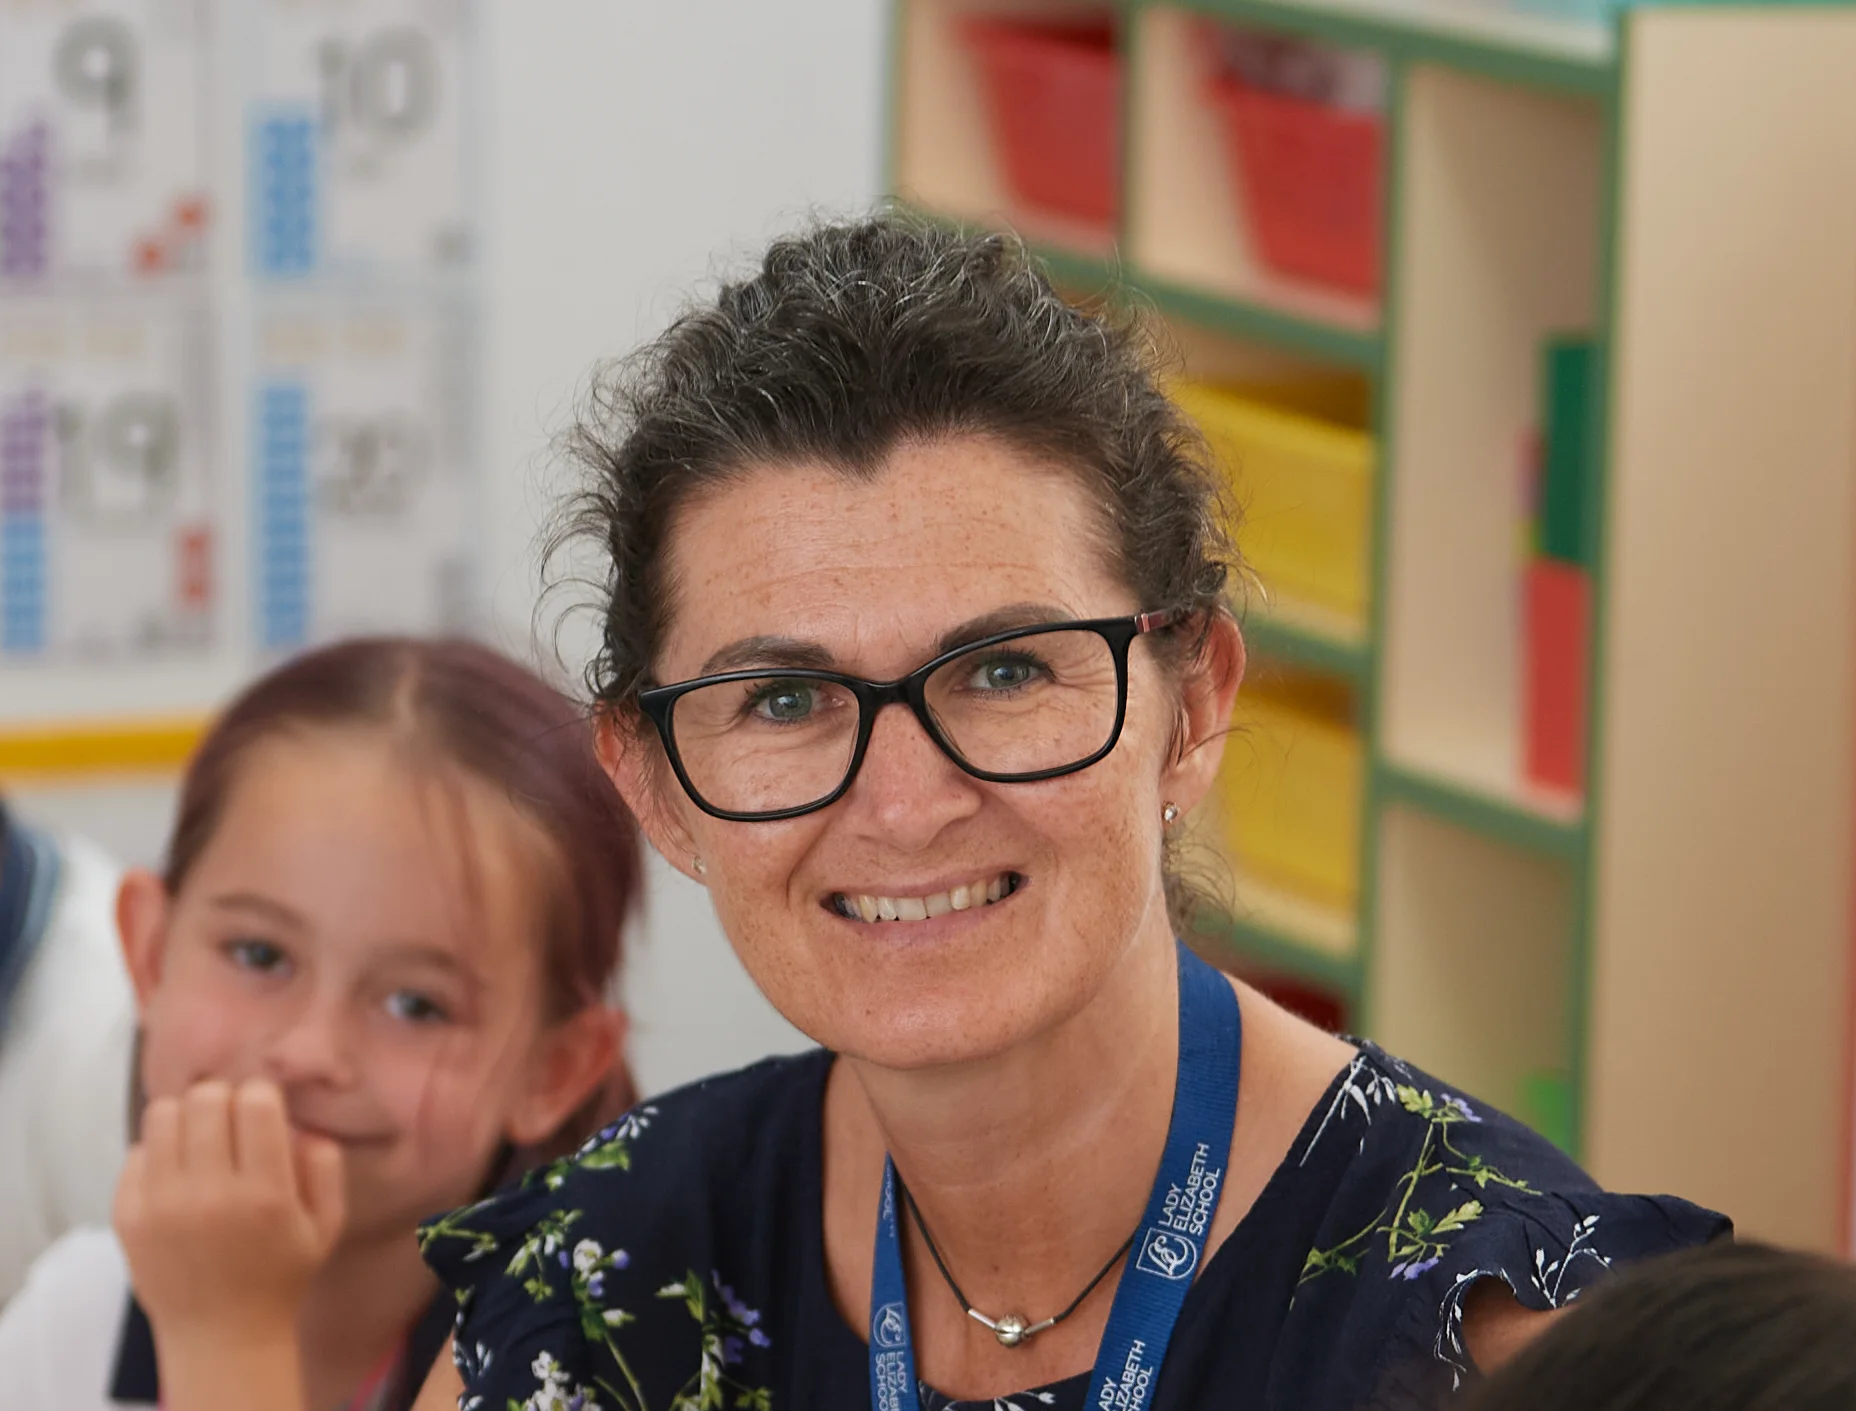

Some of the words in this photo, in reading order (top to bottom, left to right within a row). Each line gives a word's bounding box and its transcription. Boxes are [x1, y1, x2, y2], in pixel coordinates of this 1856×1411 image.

[52, 15, 138, 132] 9
[314, 25, 439, 142] 10
[52, 392, 181, 515] 19
[1158, 1182, 1182, 1227] LADY
[1172, 1142, 1210, 1232] ELIZABETH
[1188, 1167, 1221, 1236] SCHOOL
[896, 1351, 908, 1393] LADY
[1098, 1376, 1117, 1411] ADY
